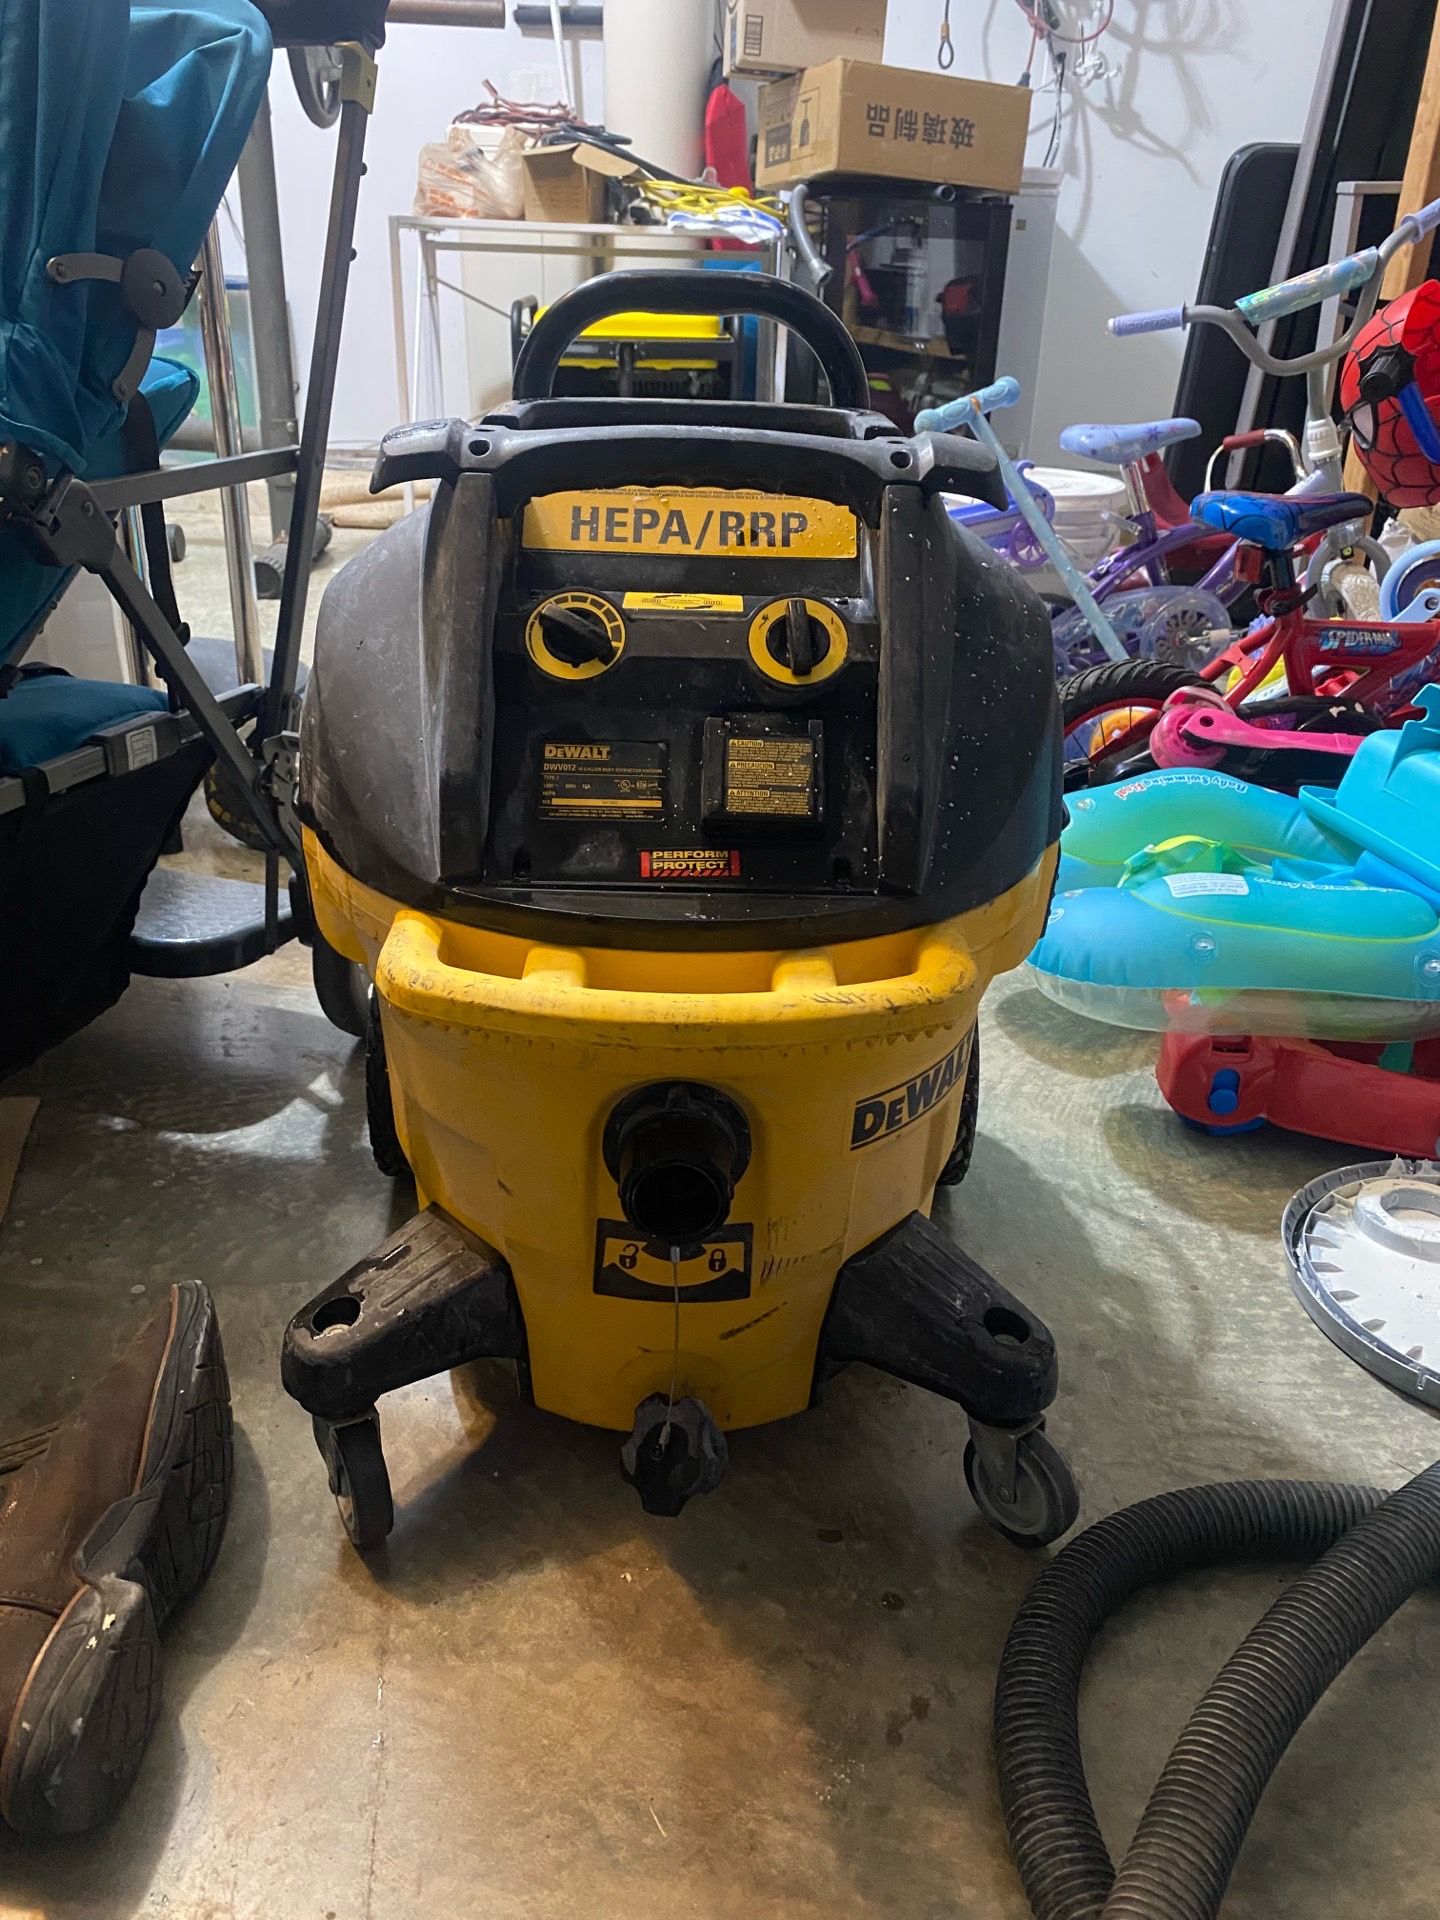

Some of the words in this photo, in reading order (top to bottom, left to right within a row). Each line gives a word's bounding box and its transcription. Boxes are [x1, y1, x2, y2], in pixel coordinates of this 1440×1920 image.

[866, 103, 975, 149] 玻璃制品
[570, 505, 809, 549] HEPA/RRP
[736, 740, 763, 748] CAUTION
[545, 745, 610, 760] DEWALT
[543, 763, 577, 771] DWV012
[652, 850, 729, 859] PERFORM
[652, 861, 727, 870] PROTECT
